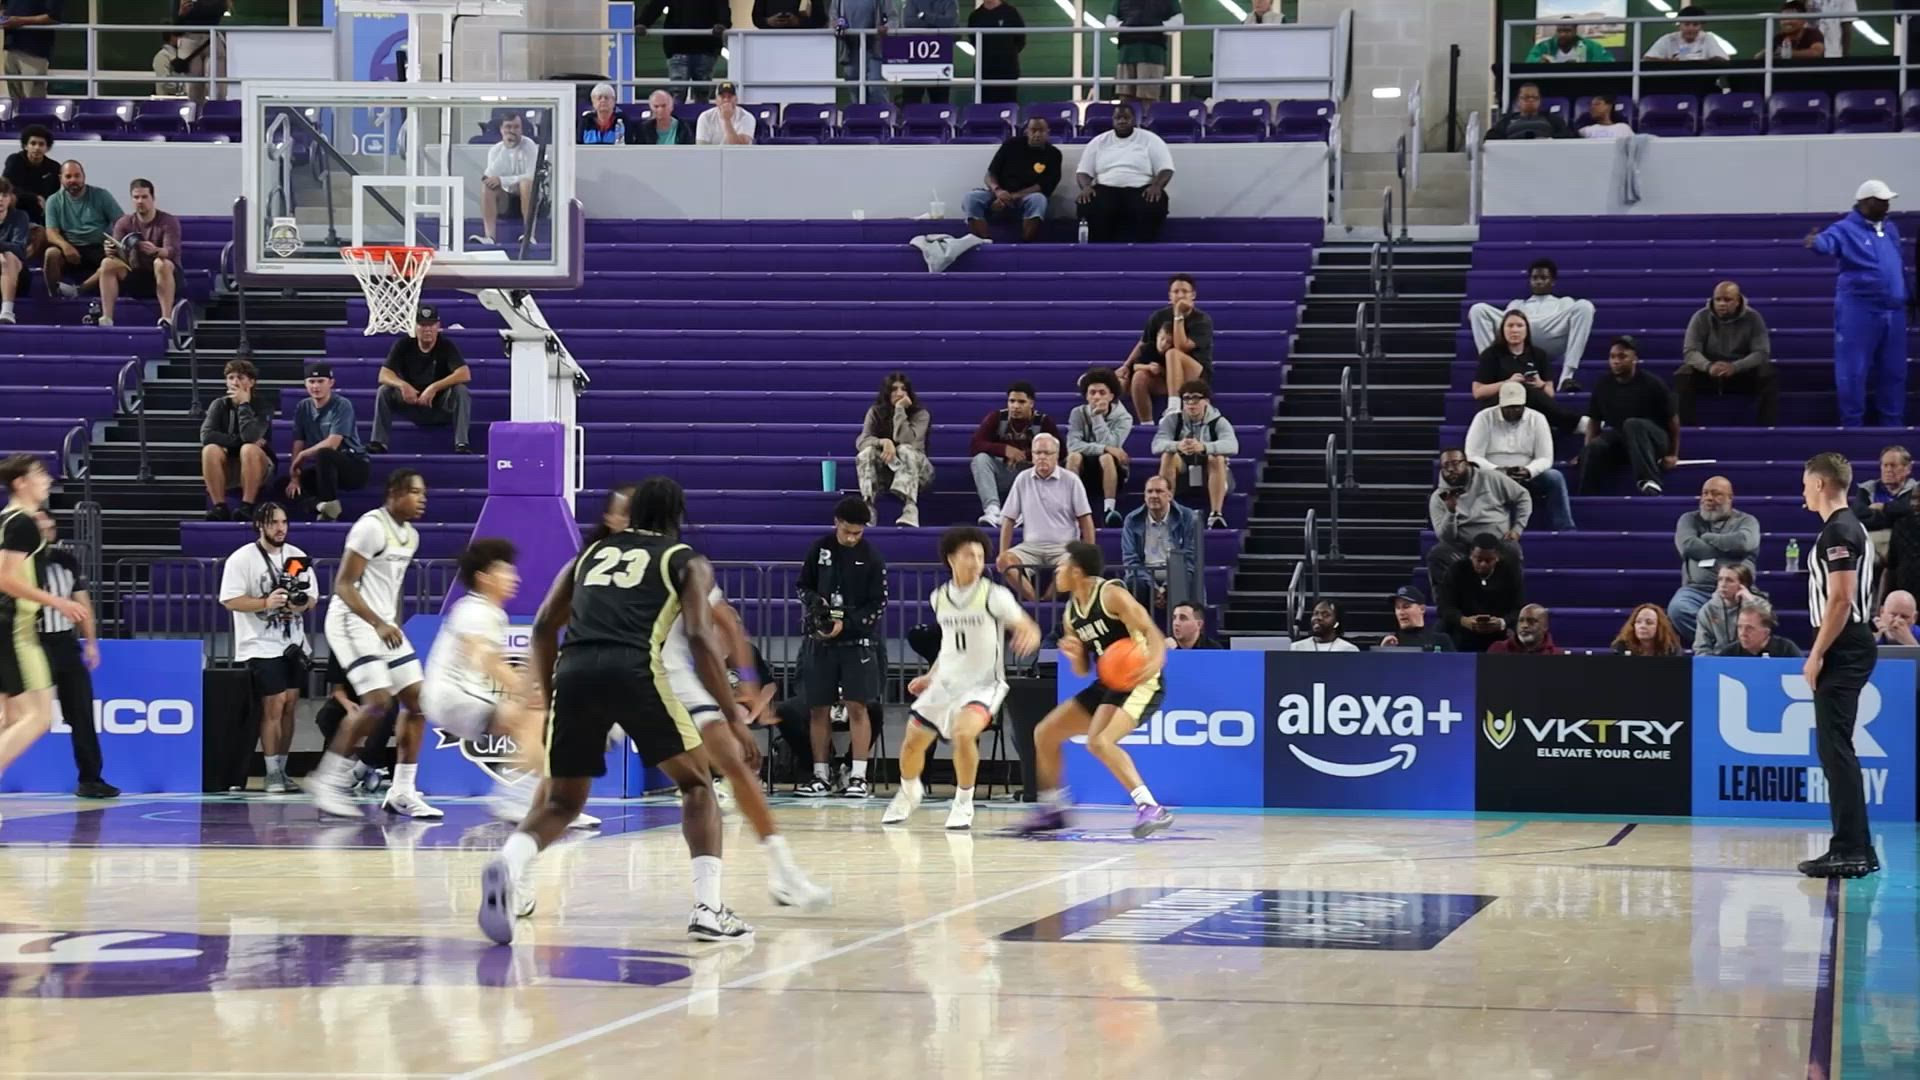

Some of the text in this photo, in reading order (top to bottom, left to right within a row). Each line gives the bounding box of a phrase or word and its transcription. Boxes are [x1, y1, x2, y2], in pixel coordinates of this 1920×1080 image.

[909, 41, 940, 59] 102
[583, 546, 651, 589] 23
[49, 698, 194, 735] ICO
[1277, 682, 1463, 736] alexa+
[1522, 718, 1685, 745] VKTRY
[1536, 747, 1671, 760] ELEVATE YOUR GAME
